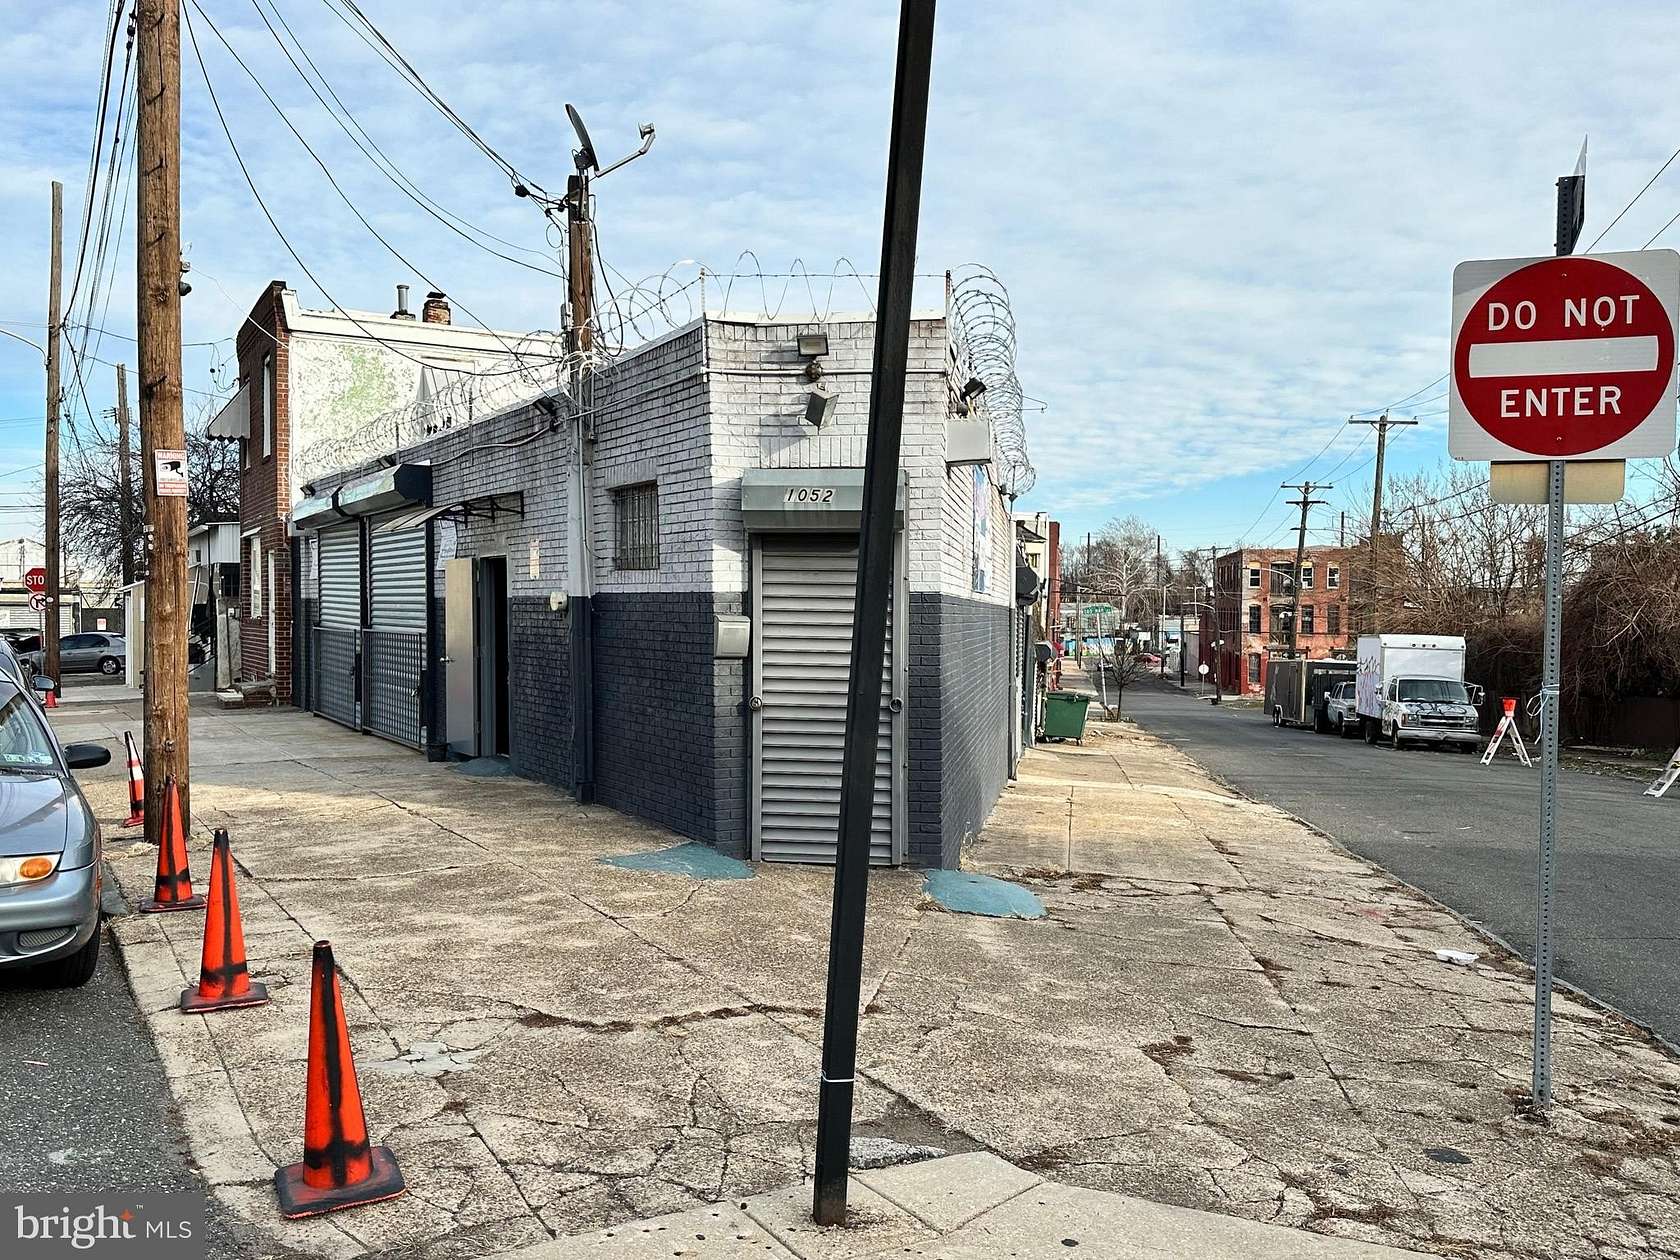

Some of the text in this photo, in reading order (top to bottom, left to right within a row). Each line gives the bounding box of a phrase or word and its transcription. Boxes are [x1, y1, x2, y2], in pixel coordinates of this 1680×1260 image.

[1488, 295, 1640, 331] DO NOT
[1501, 386, 1622, 418] ENTER
[787, 488, 833, 502] 1052
[26, 575, 45, 586] STO
